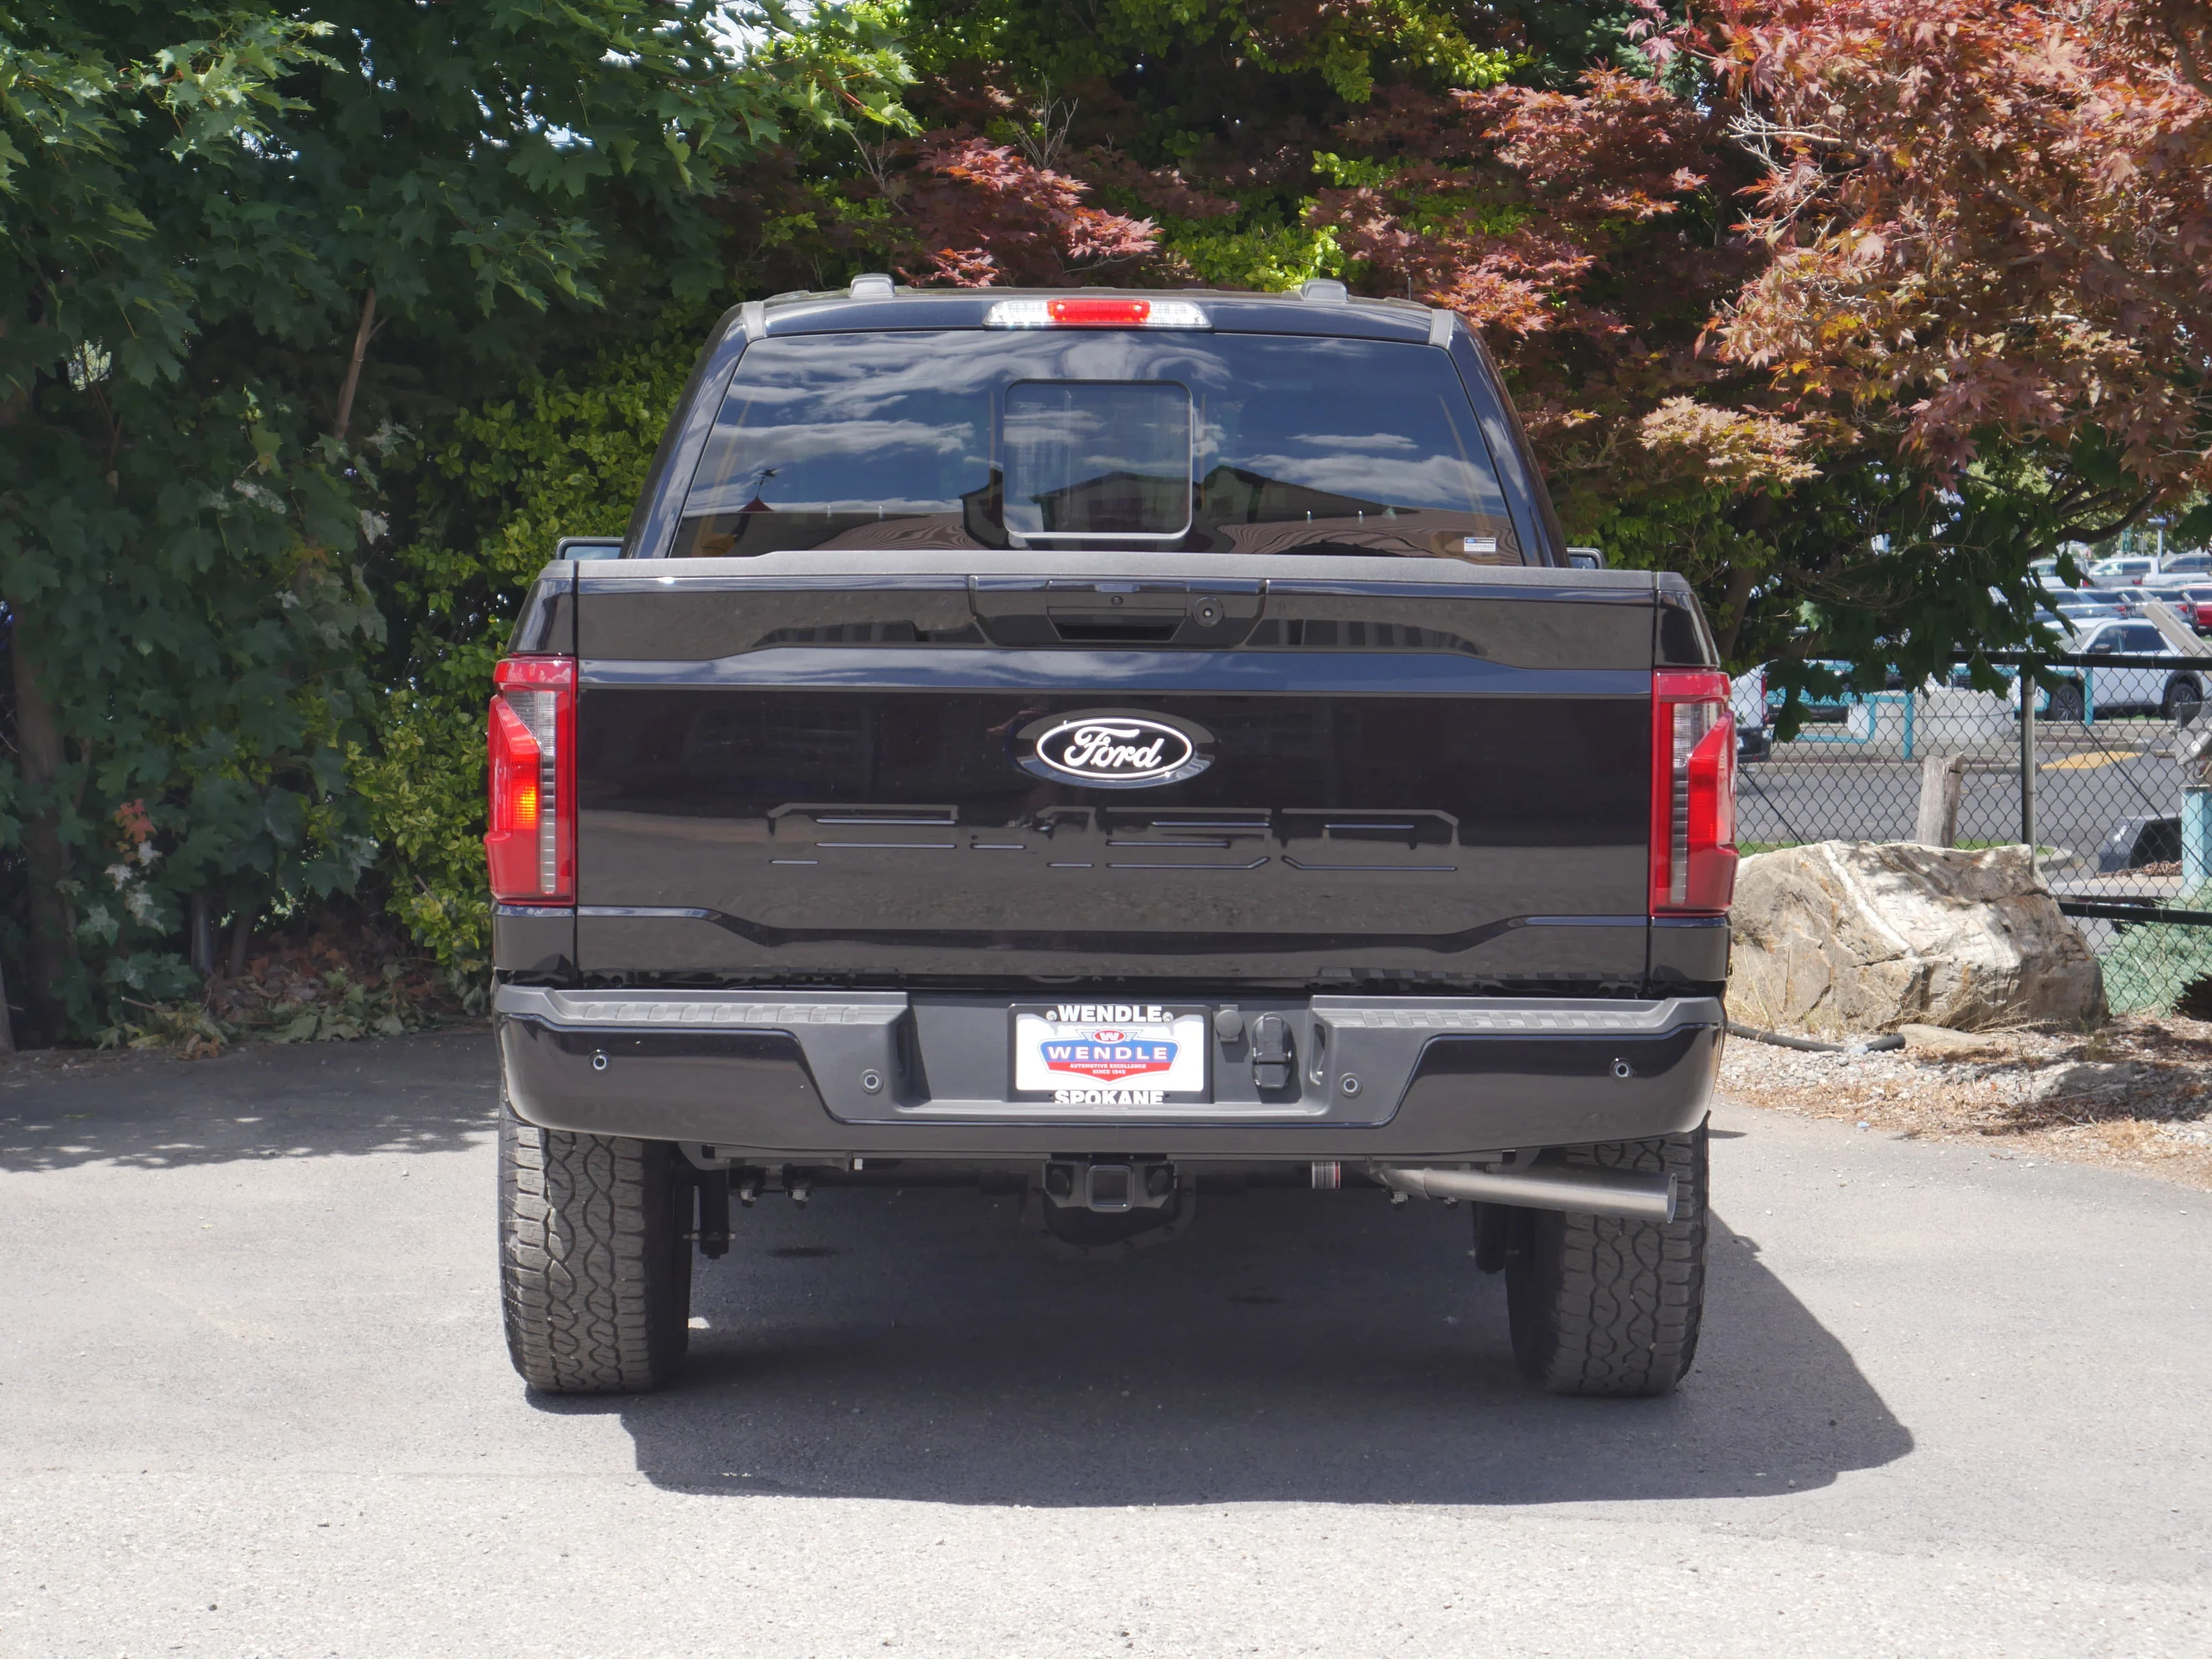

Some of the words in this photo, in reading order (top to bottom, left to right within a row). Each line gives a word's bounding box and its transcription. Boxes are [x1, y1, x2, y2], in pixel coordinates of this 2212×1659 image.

[1064, 726, 1165, 767] Ford
[1057, 1005, 1162, 1022] WENDLE
[1048, 1046, 1168, 1059] WENDLE
[1055, 1090, 1163, 1105] SPOKANE
